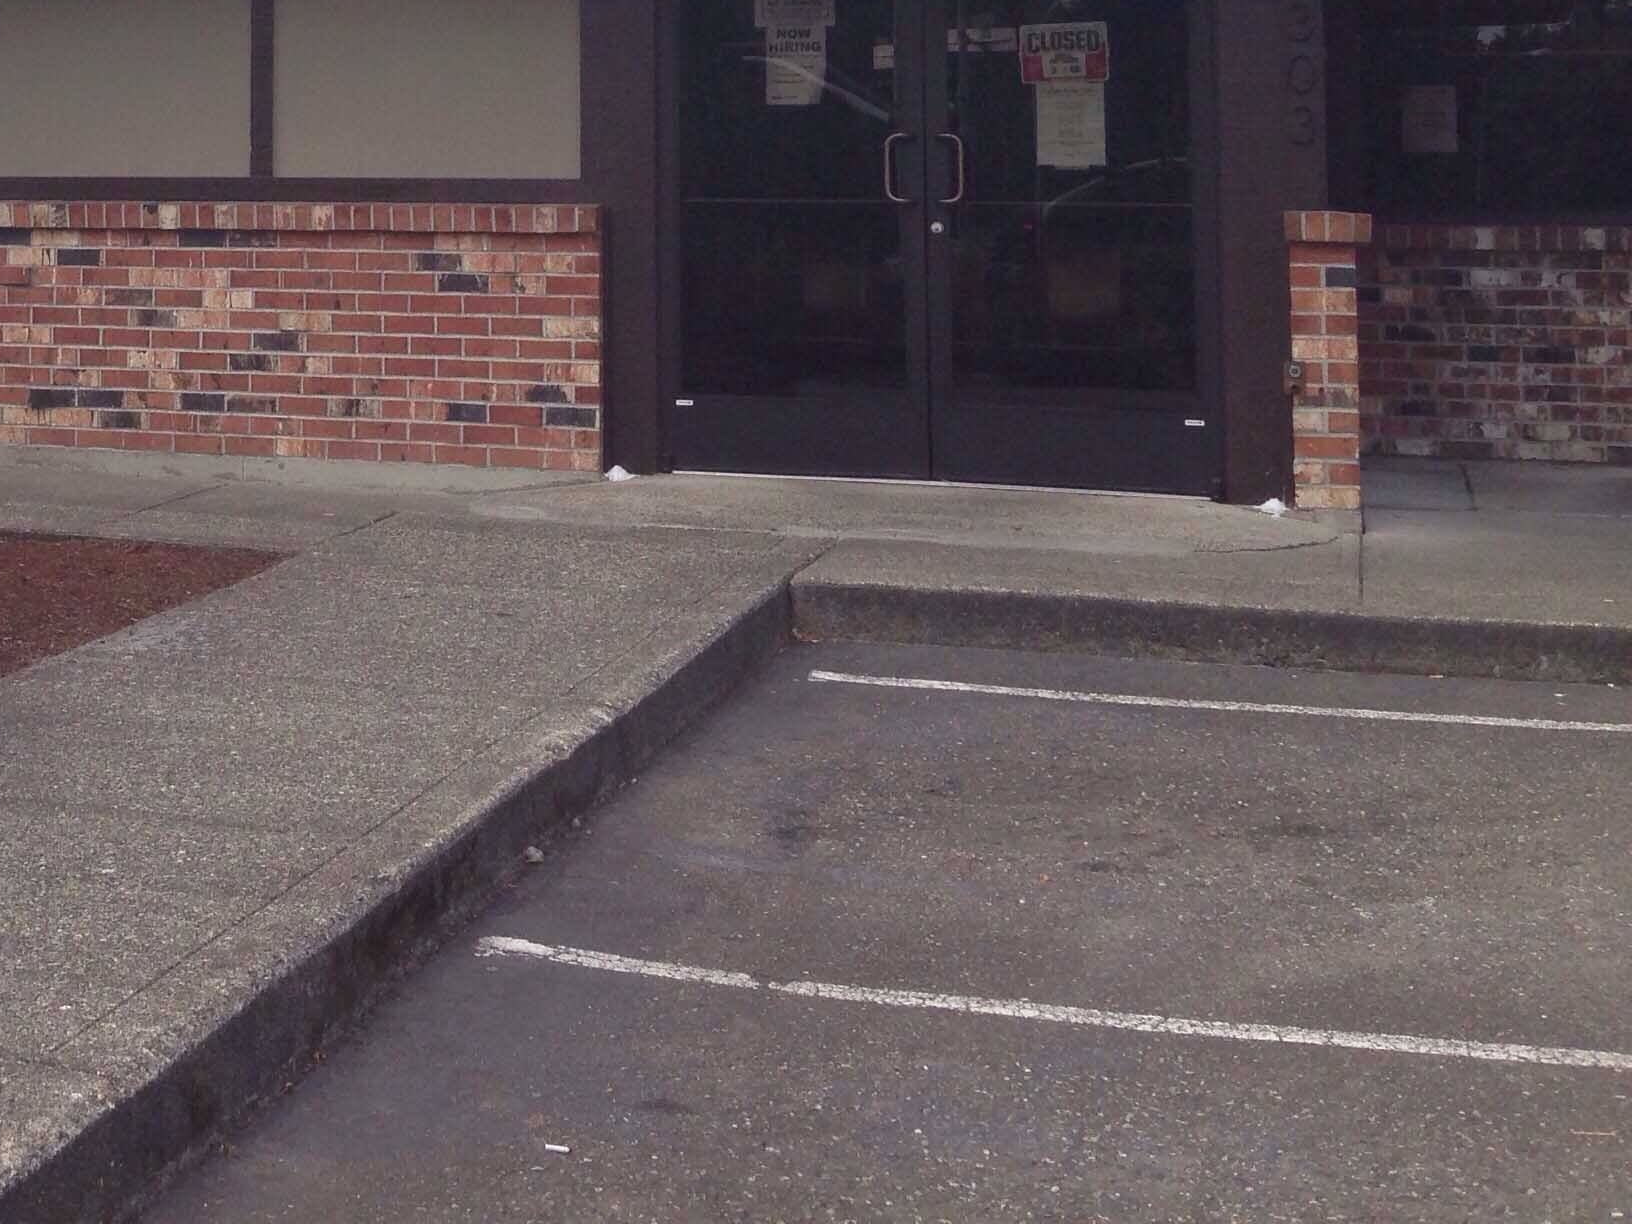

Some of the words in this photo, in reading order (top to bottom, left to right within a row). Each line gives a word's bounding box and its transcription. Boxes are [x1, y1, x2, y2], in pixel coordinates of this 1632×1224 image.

[776, 27, 811, 40] NOW
[768, 41, 822, 54] HIRING
[1027, 30, 1101, 54] CLOSED
